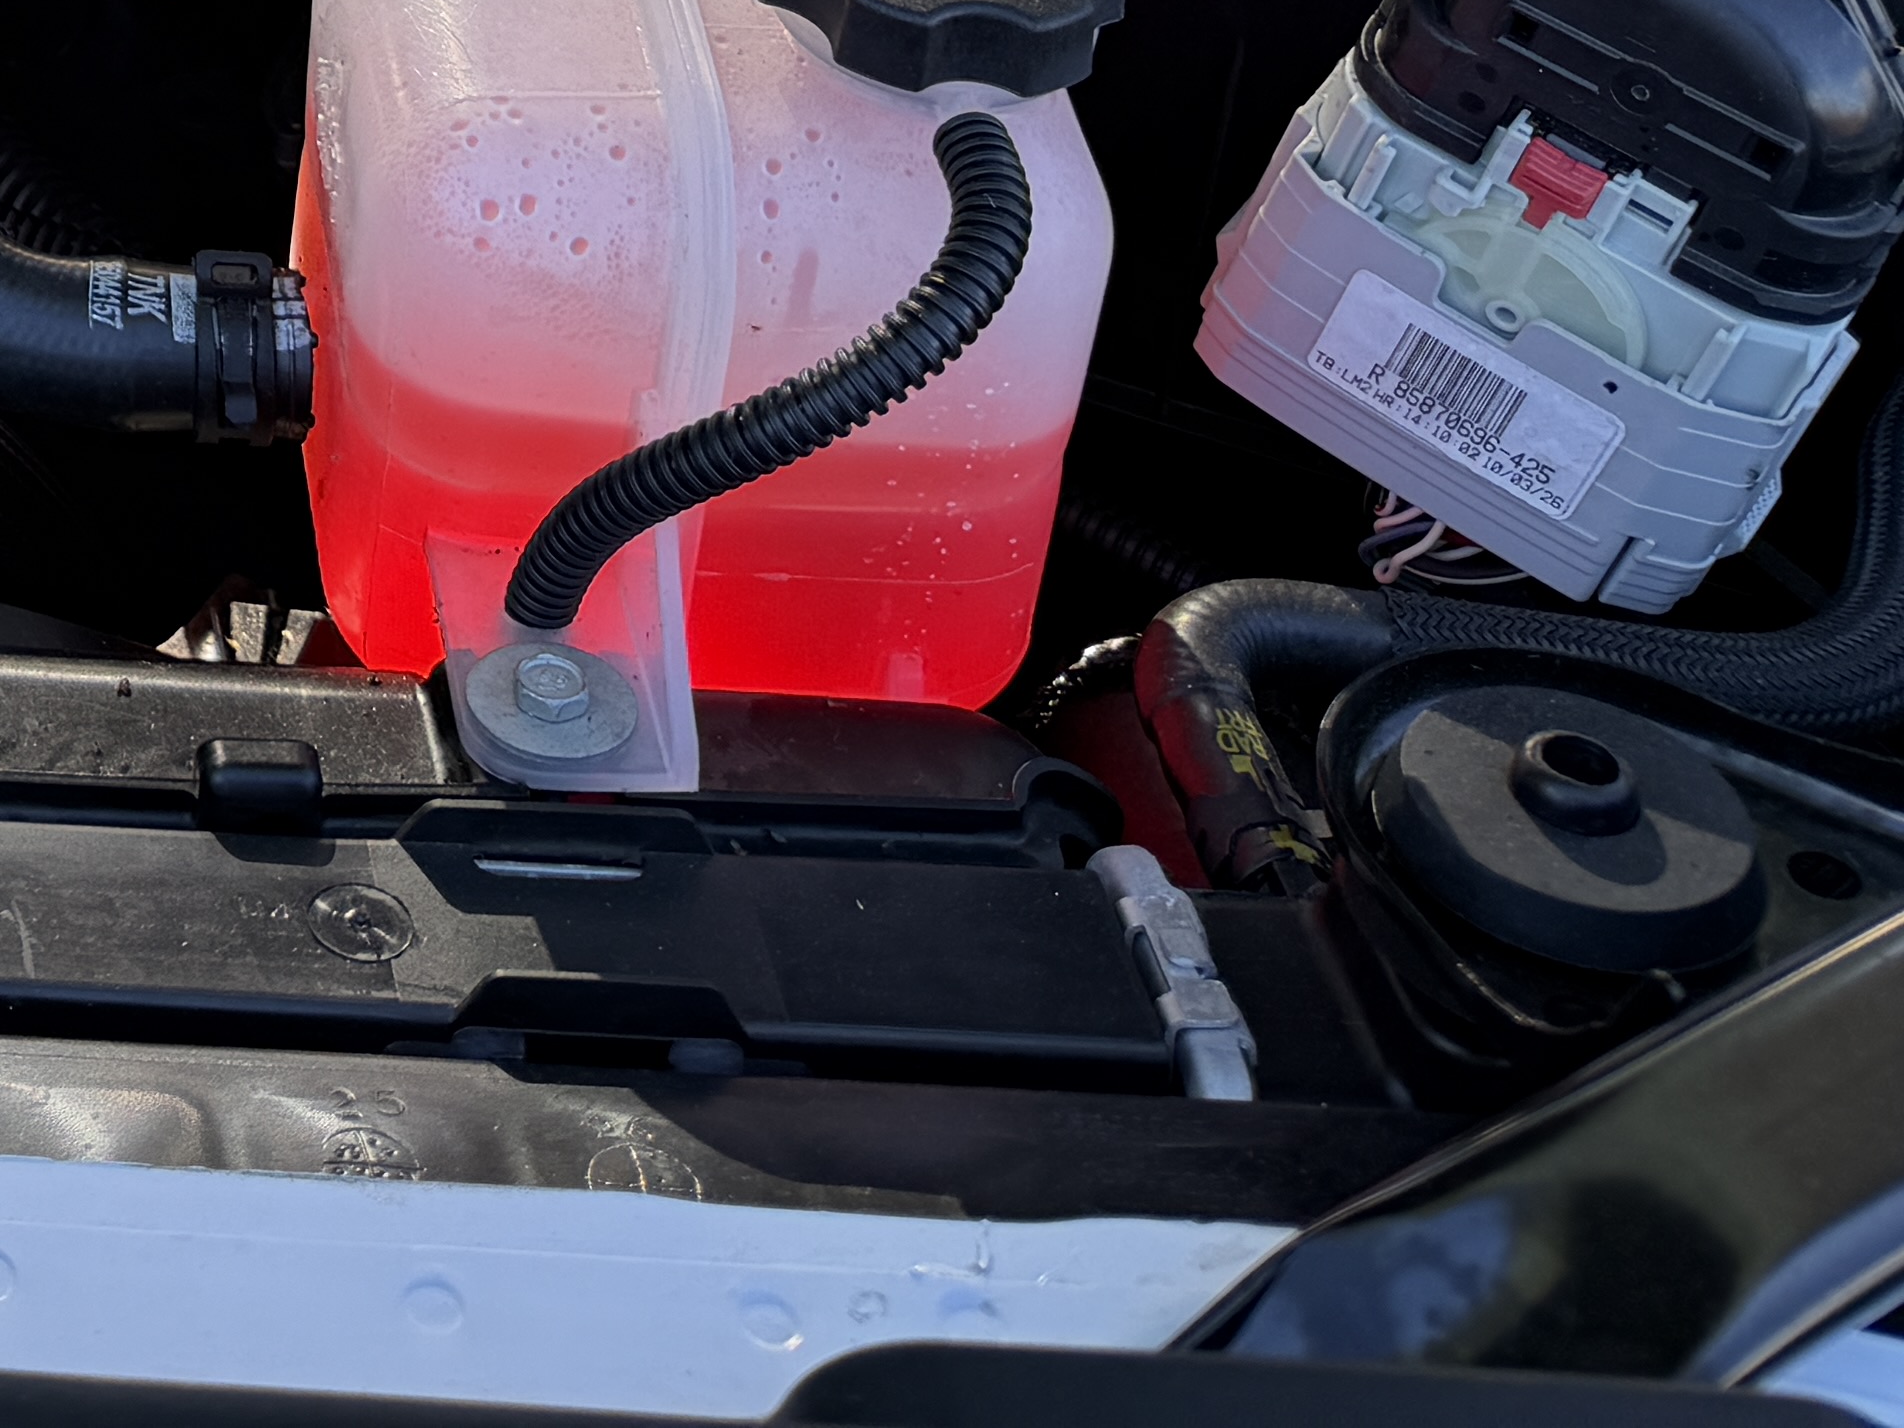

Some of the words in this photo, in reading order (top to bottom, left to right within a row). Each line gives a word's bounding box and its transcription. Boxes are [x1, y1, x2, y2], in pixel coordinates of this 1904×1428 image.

[127, 271, 168, 324] TNK
[1366, 363, 1388, 386] R
[1391, 377, 1557, 488] 85870696-425
[1481, 455, 1565, 512] 10/03/26
[1216, 730, 1269, 760] RAD
